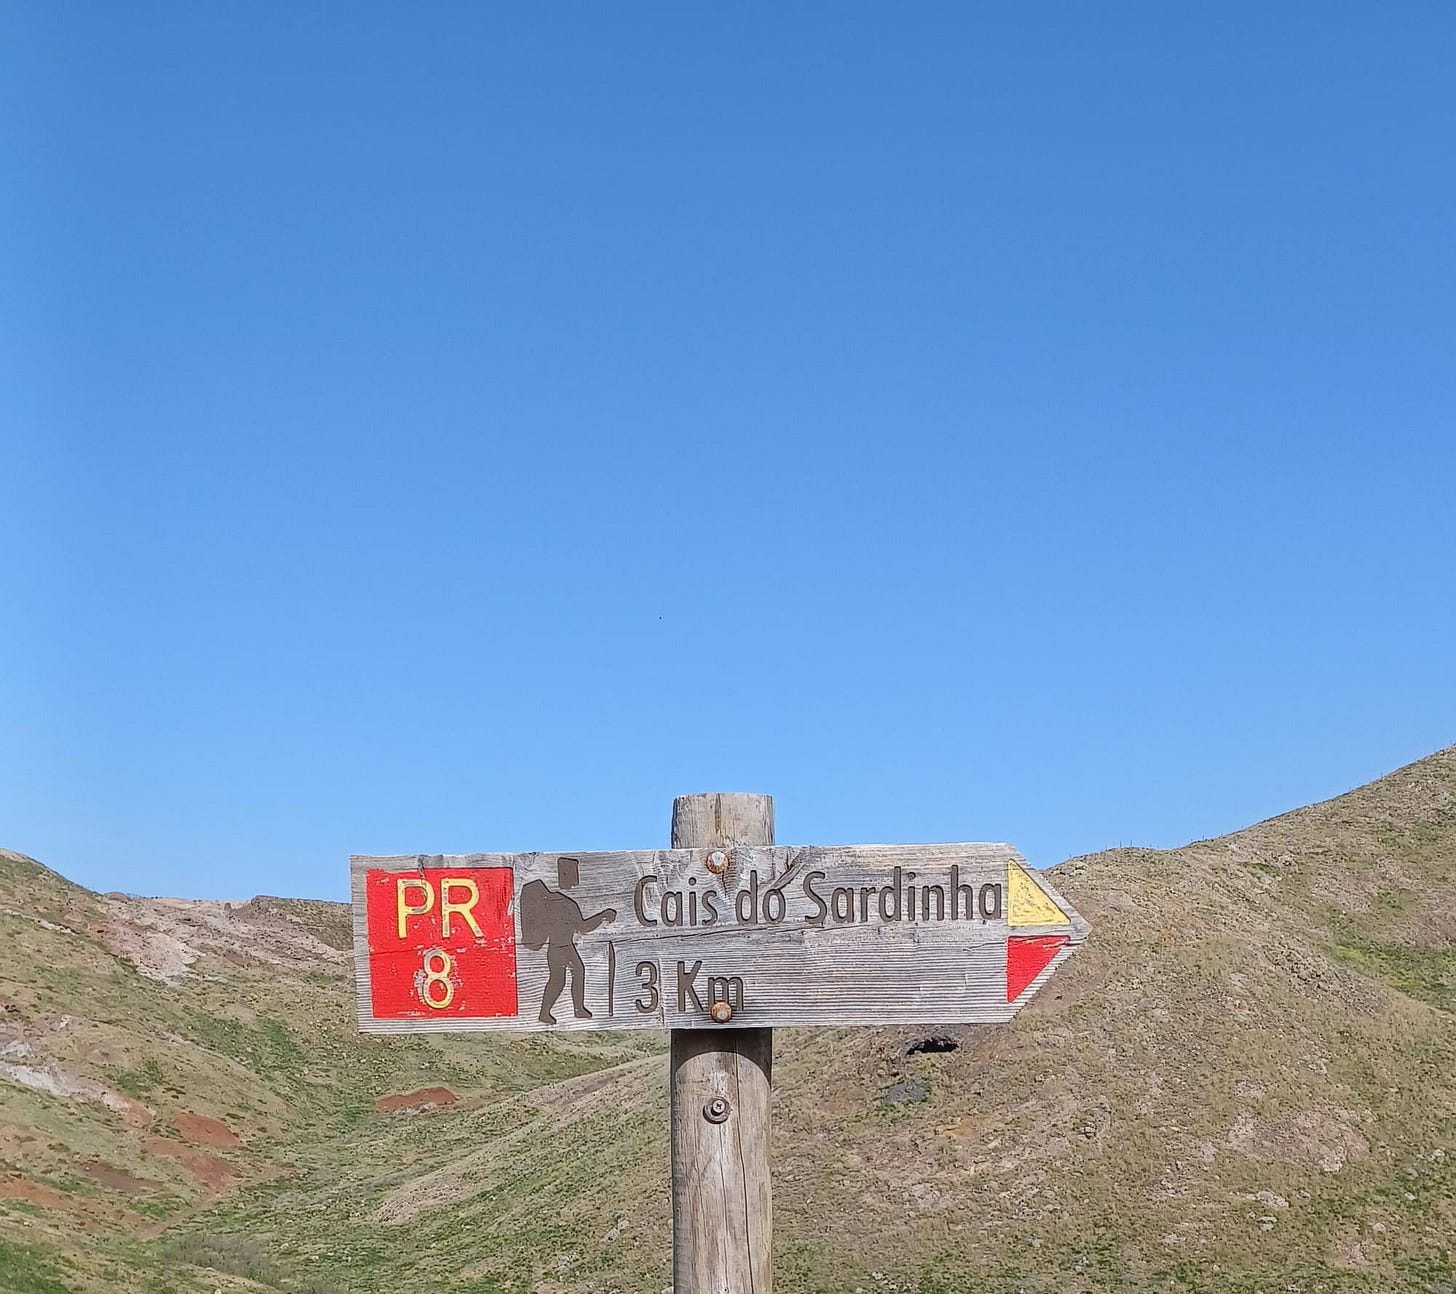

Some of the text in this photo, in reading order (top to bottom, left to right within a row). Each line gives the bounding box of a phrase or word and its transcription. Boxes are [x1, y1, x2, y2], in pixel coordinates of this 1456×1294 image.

[396, 877, 484, 939] PR
[634, 864, 1002, 927] Cais do Sardinha
[421, 949, 454, 1009] 8
[634, 960, 745, 1014] 3 Km
